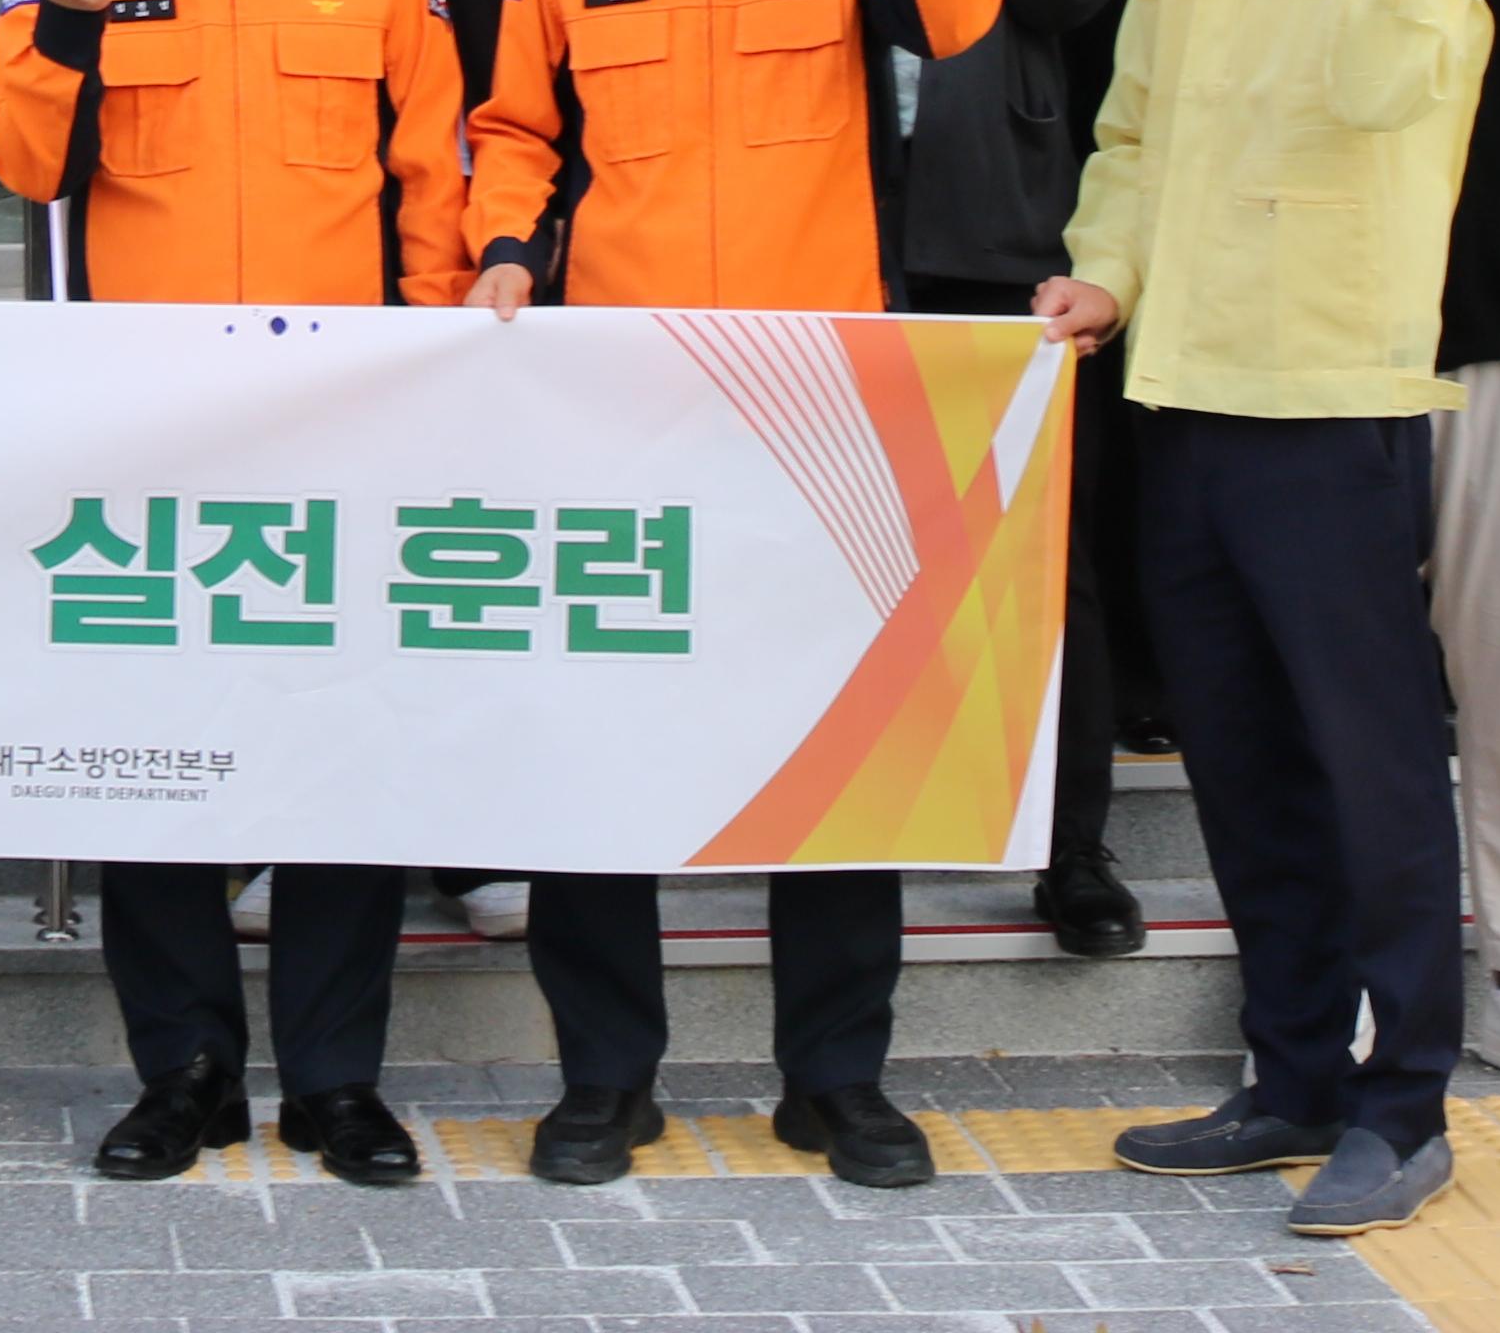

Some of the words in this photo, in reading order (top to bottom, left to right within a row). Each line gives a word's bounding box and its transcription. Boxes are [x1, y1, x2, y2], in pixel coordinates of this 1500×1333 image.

[30, 497, 336, 646] 실전
[388, 498, 690, 654] 훈련
[11, 785, 66, 799] DAEGU
[69, 786, 103, 800] FIRE
[106, 787, 209, 802] DEPARTMENT
